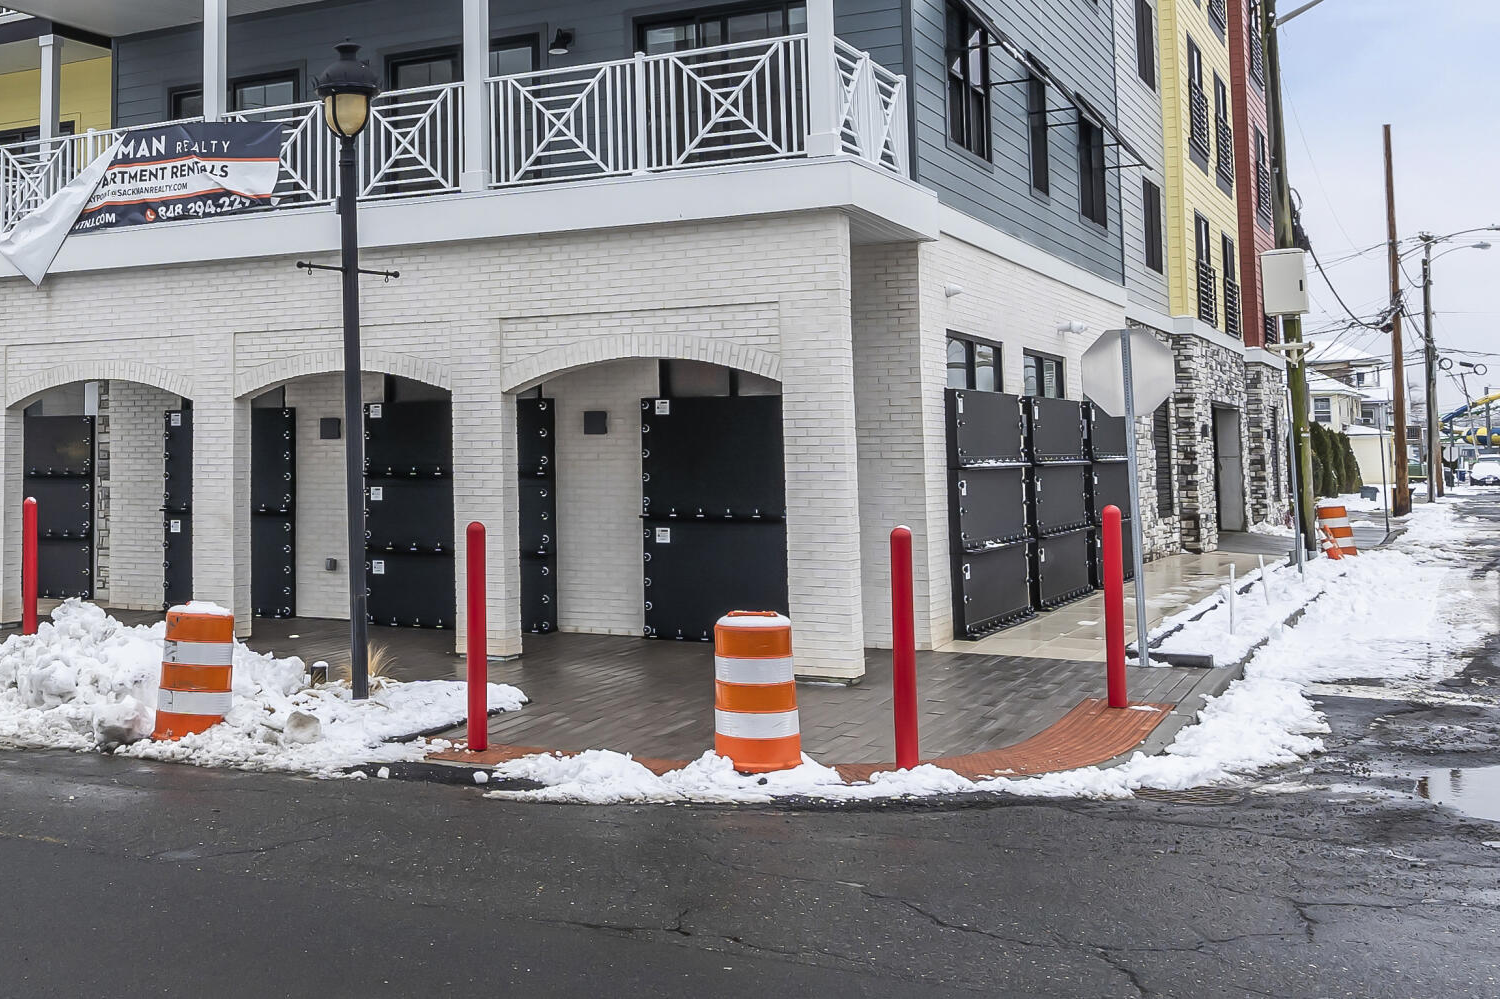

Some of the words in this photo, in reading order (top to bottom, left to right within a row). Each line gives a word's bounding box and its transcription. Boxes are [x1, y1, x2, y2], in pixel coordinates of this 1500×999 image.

[112, 135, 166, 160] MAN
[175, 140, 231, 154] REALTY
[171, 161, 229, 179] RENTALS
